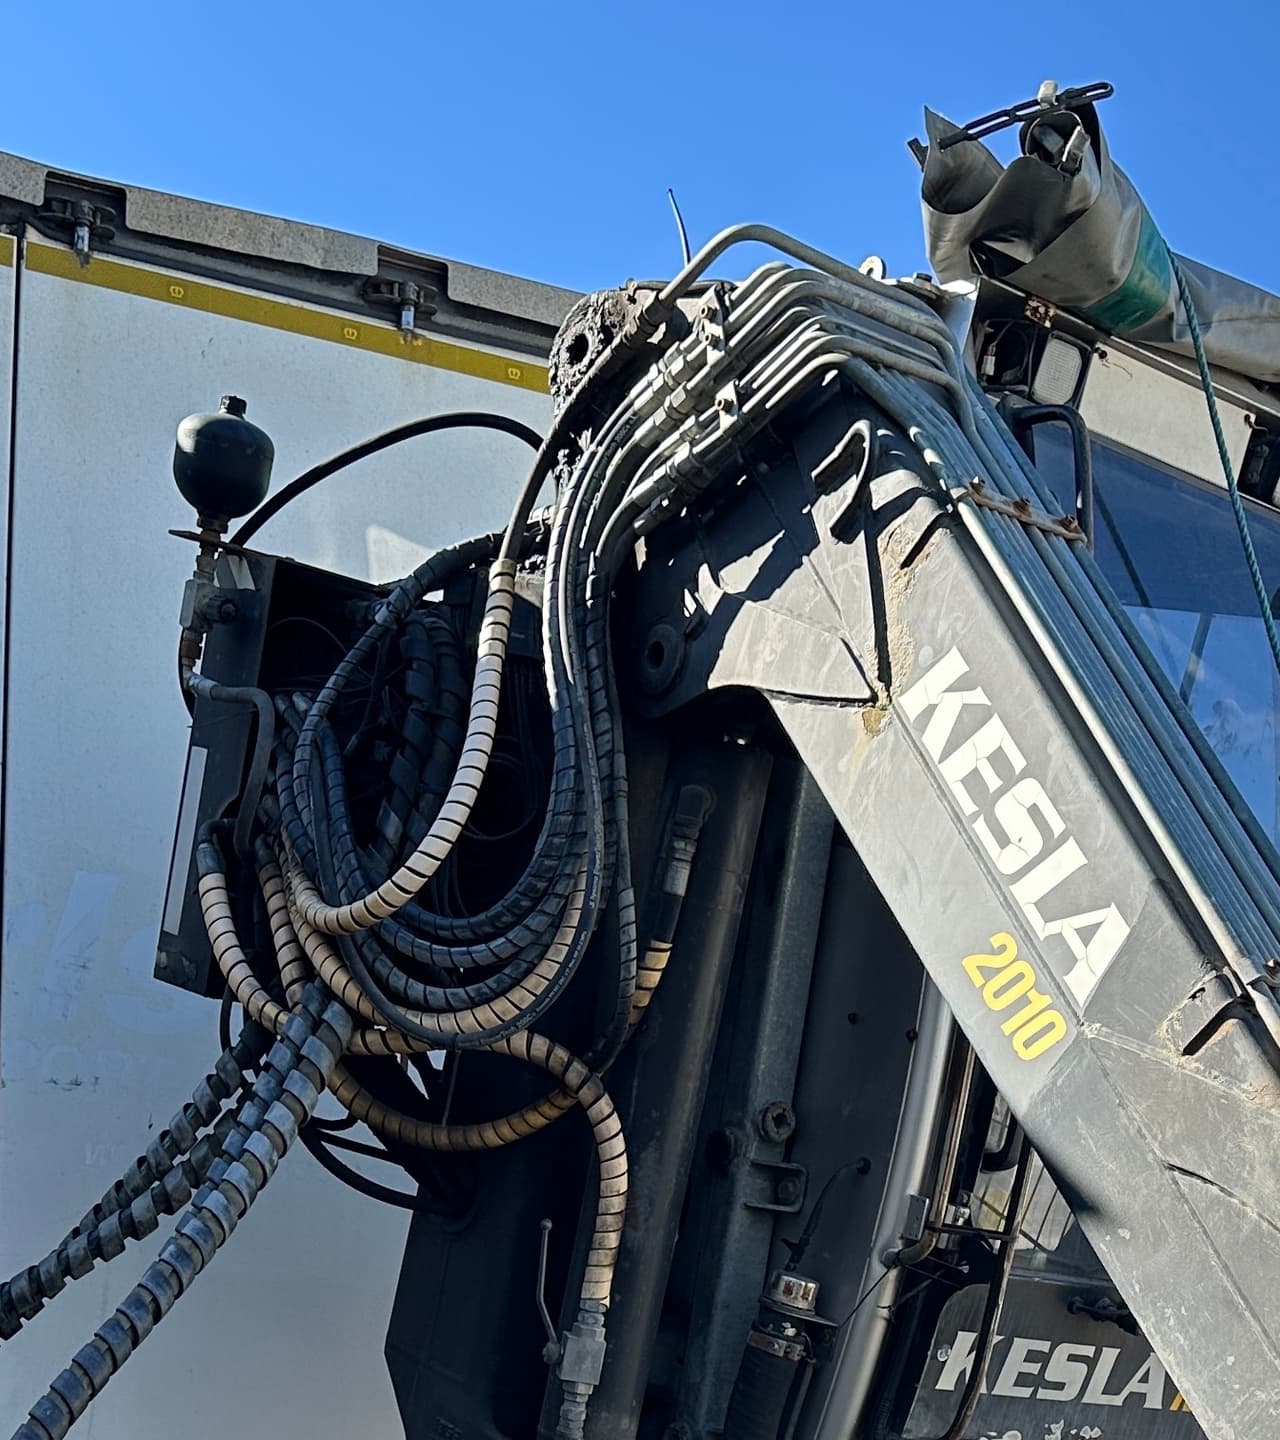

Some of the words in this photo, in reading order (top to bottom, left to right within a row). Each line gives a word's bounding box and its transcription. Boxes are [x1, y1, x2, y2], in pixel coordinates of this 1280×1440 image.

[898, 645, 1131, 1008] KESLA
[961, 931, 1067, 1061] 2010
[934, 1330, 1170, 1411] KESLA
